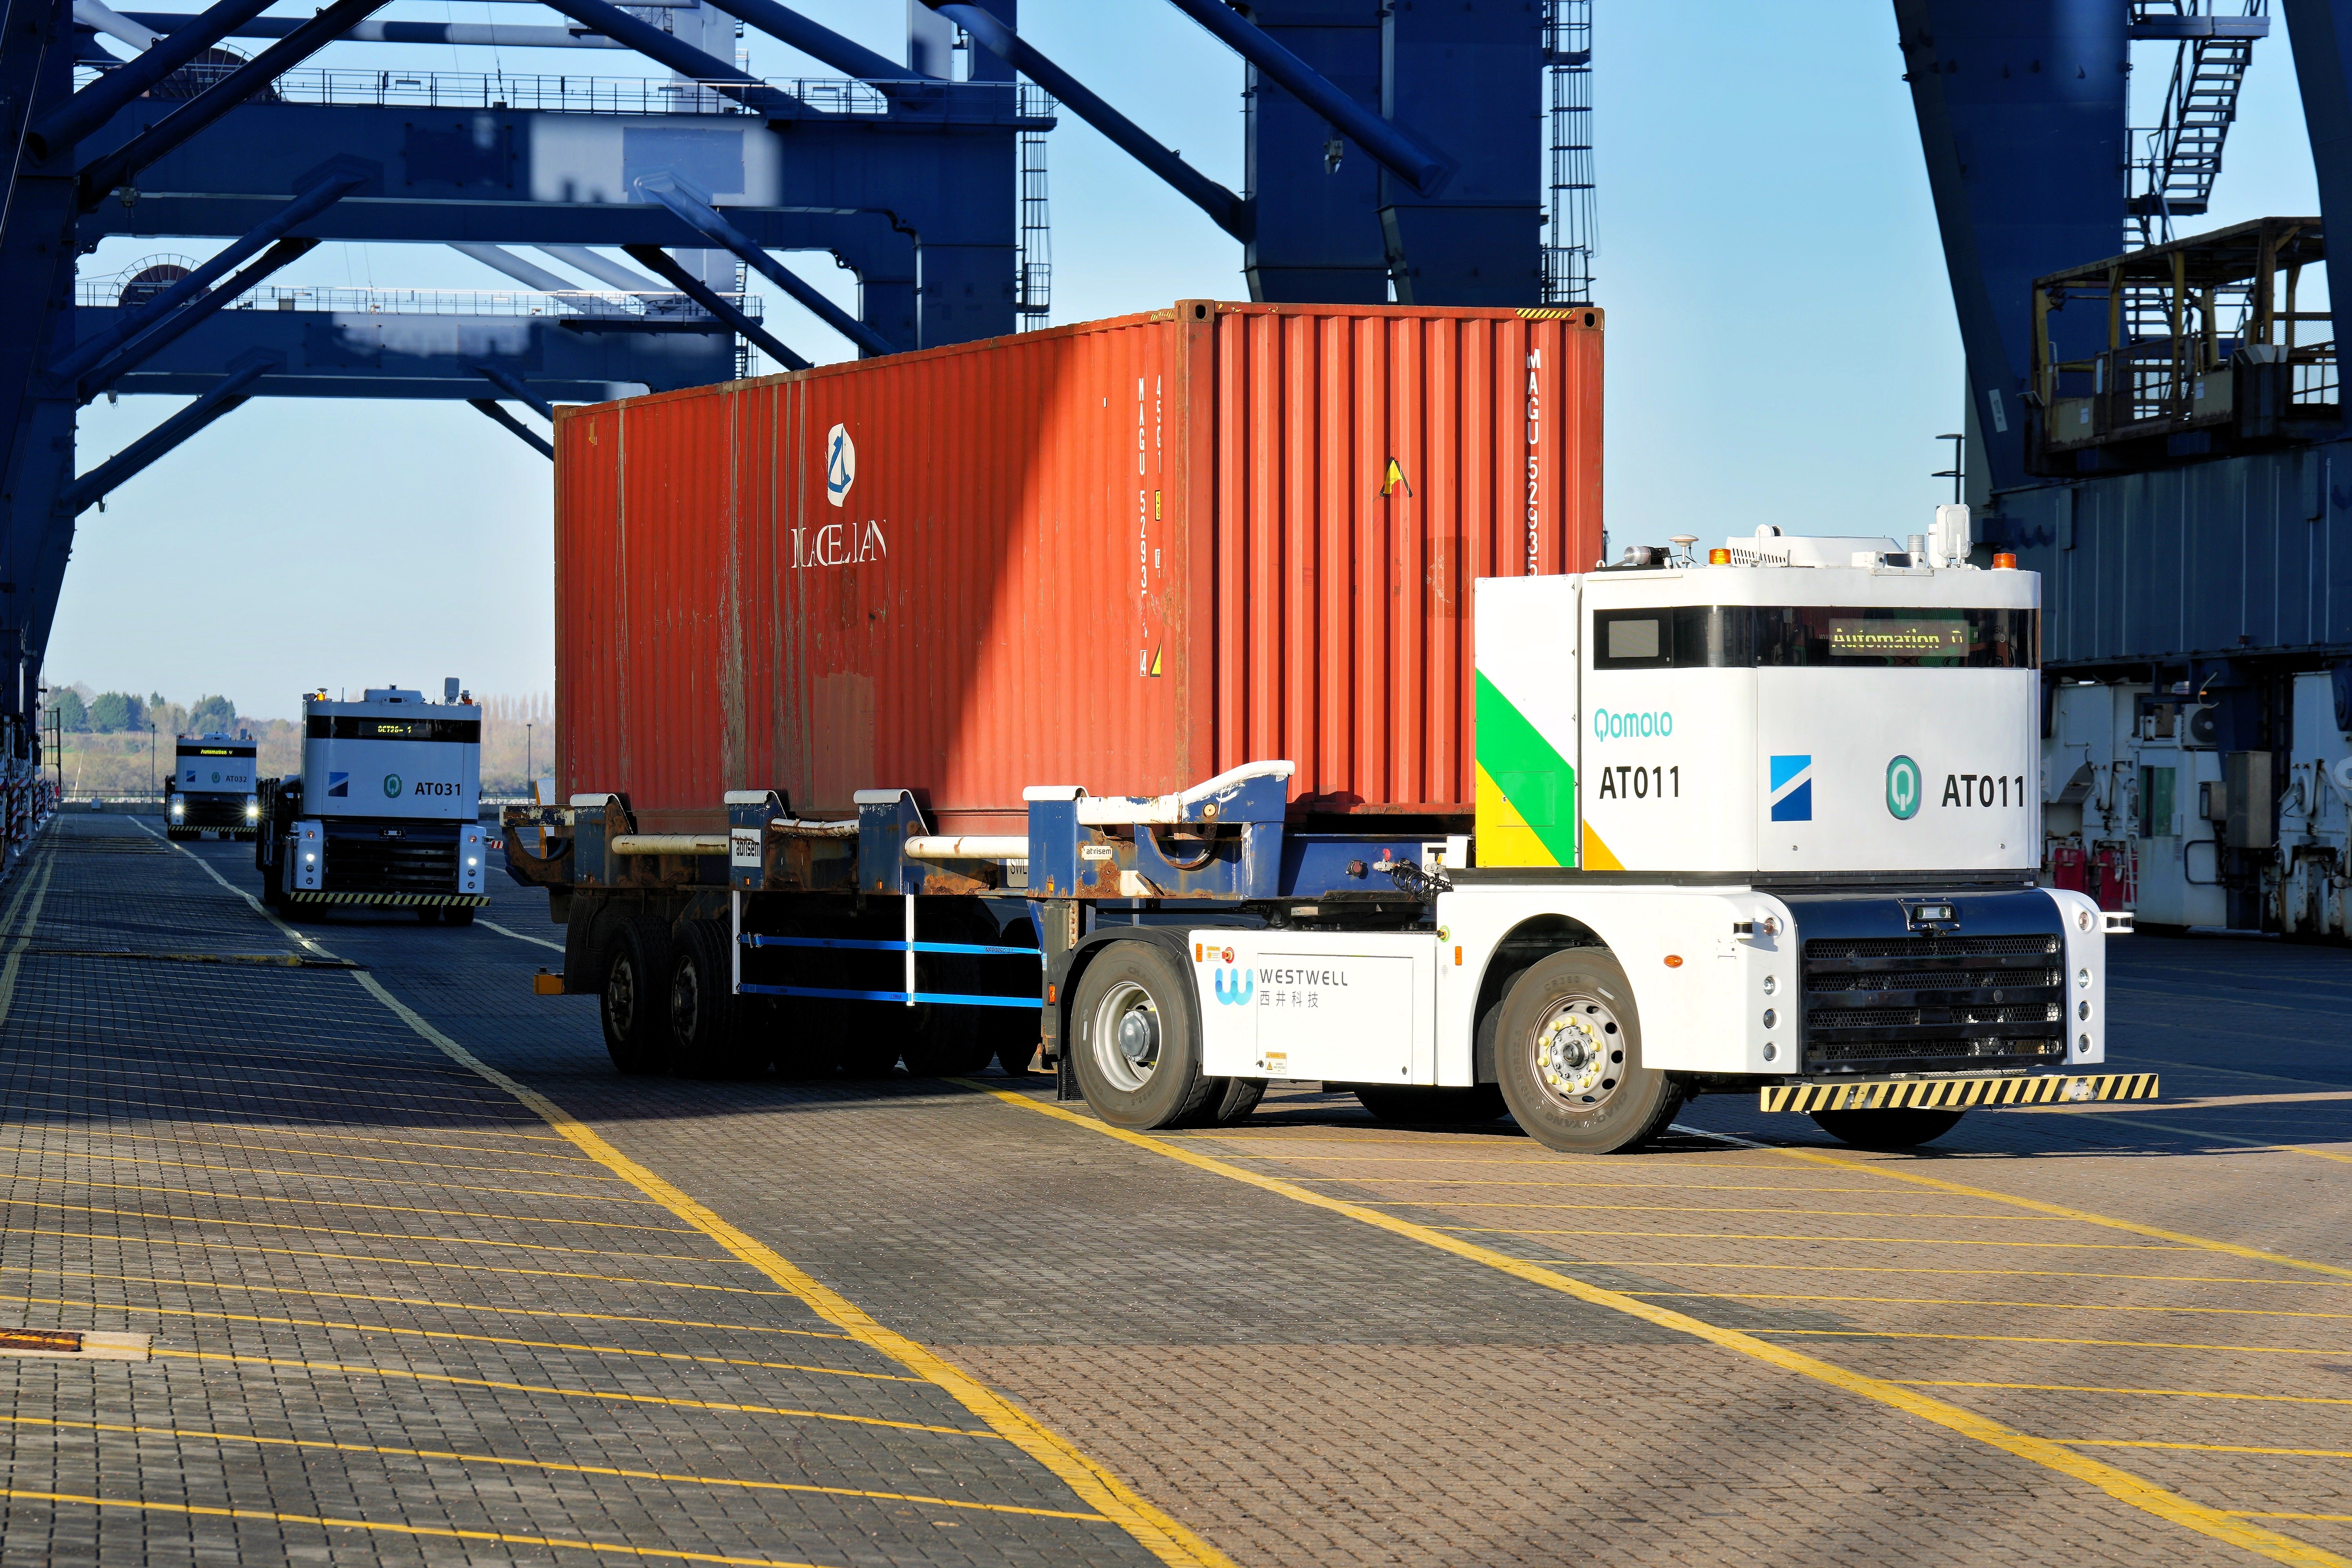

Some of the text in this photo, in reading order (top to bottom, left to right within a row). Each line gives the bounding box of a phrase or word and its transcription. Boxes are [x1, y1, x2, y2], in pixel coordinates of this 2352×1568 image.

[1832, 628, 1939, 648] Automation
[1594, 708, 1672, 742] Qomolo
[414, 782, 460, 796] AT031
[1599, 766, 1679, 799] AT011
[1942, 774, 2023, 807] AT011
[1010, 858, 1027, 875] SWL
[1259, 969, 1348, 986] WESTWELL
[1260, 990, 1318, 1007] 西井科技
